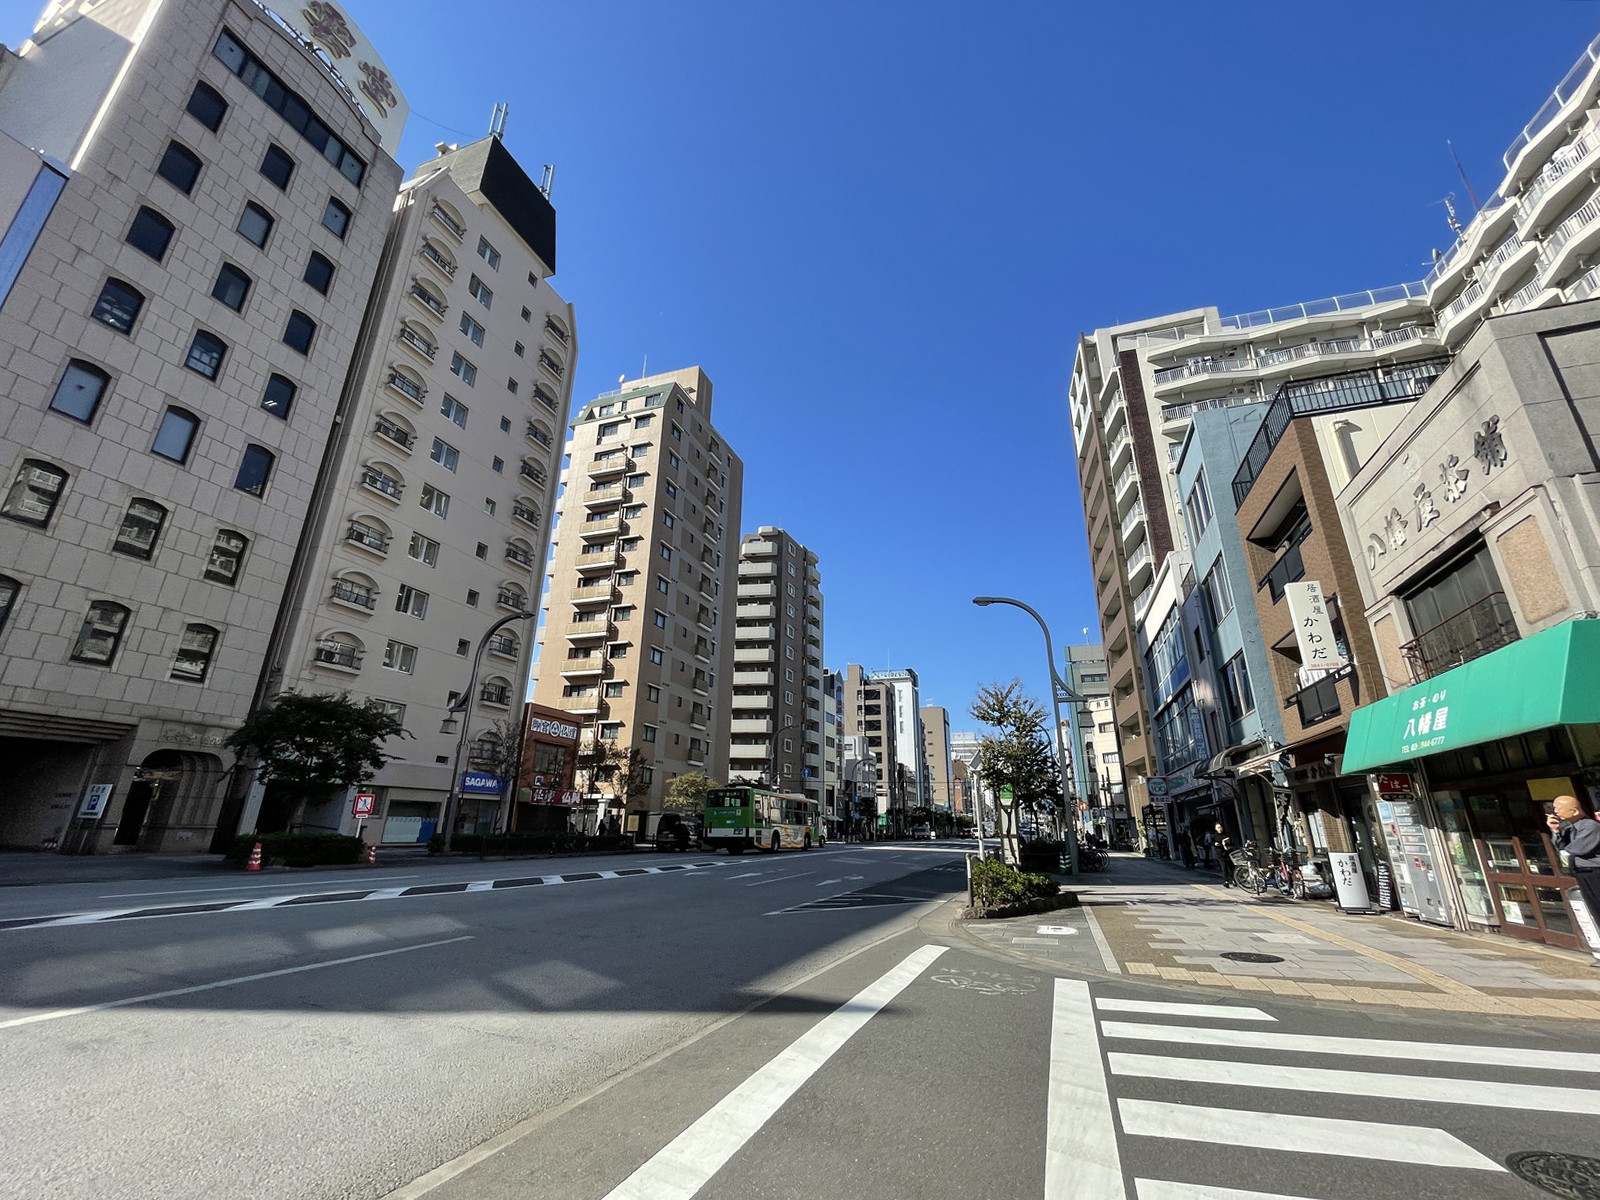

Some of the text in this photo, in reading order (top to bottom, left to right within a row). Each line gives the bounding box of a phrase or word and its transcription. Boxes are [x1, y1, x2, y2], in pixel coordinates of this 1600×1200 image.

[1306, 583, 1324, 615] 居酒屋
[1303, 616, 1328, 660] かわだ
[1403, 706, 1449, 740] 八幡屋
[464, 776, 498, 789] SAGAWA
[1337, 859, 1353, 887] かわだ
